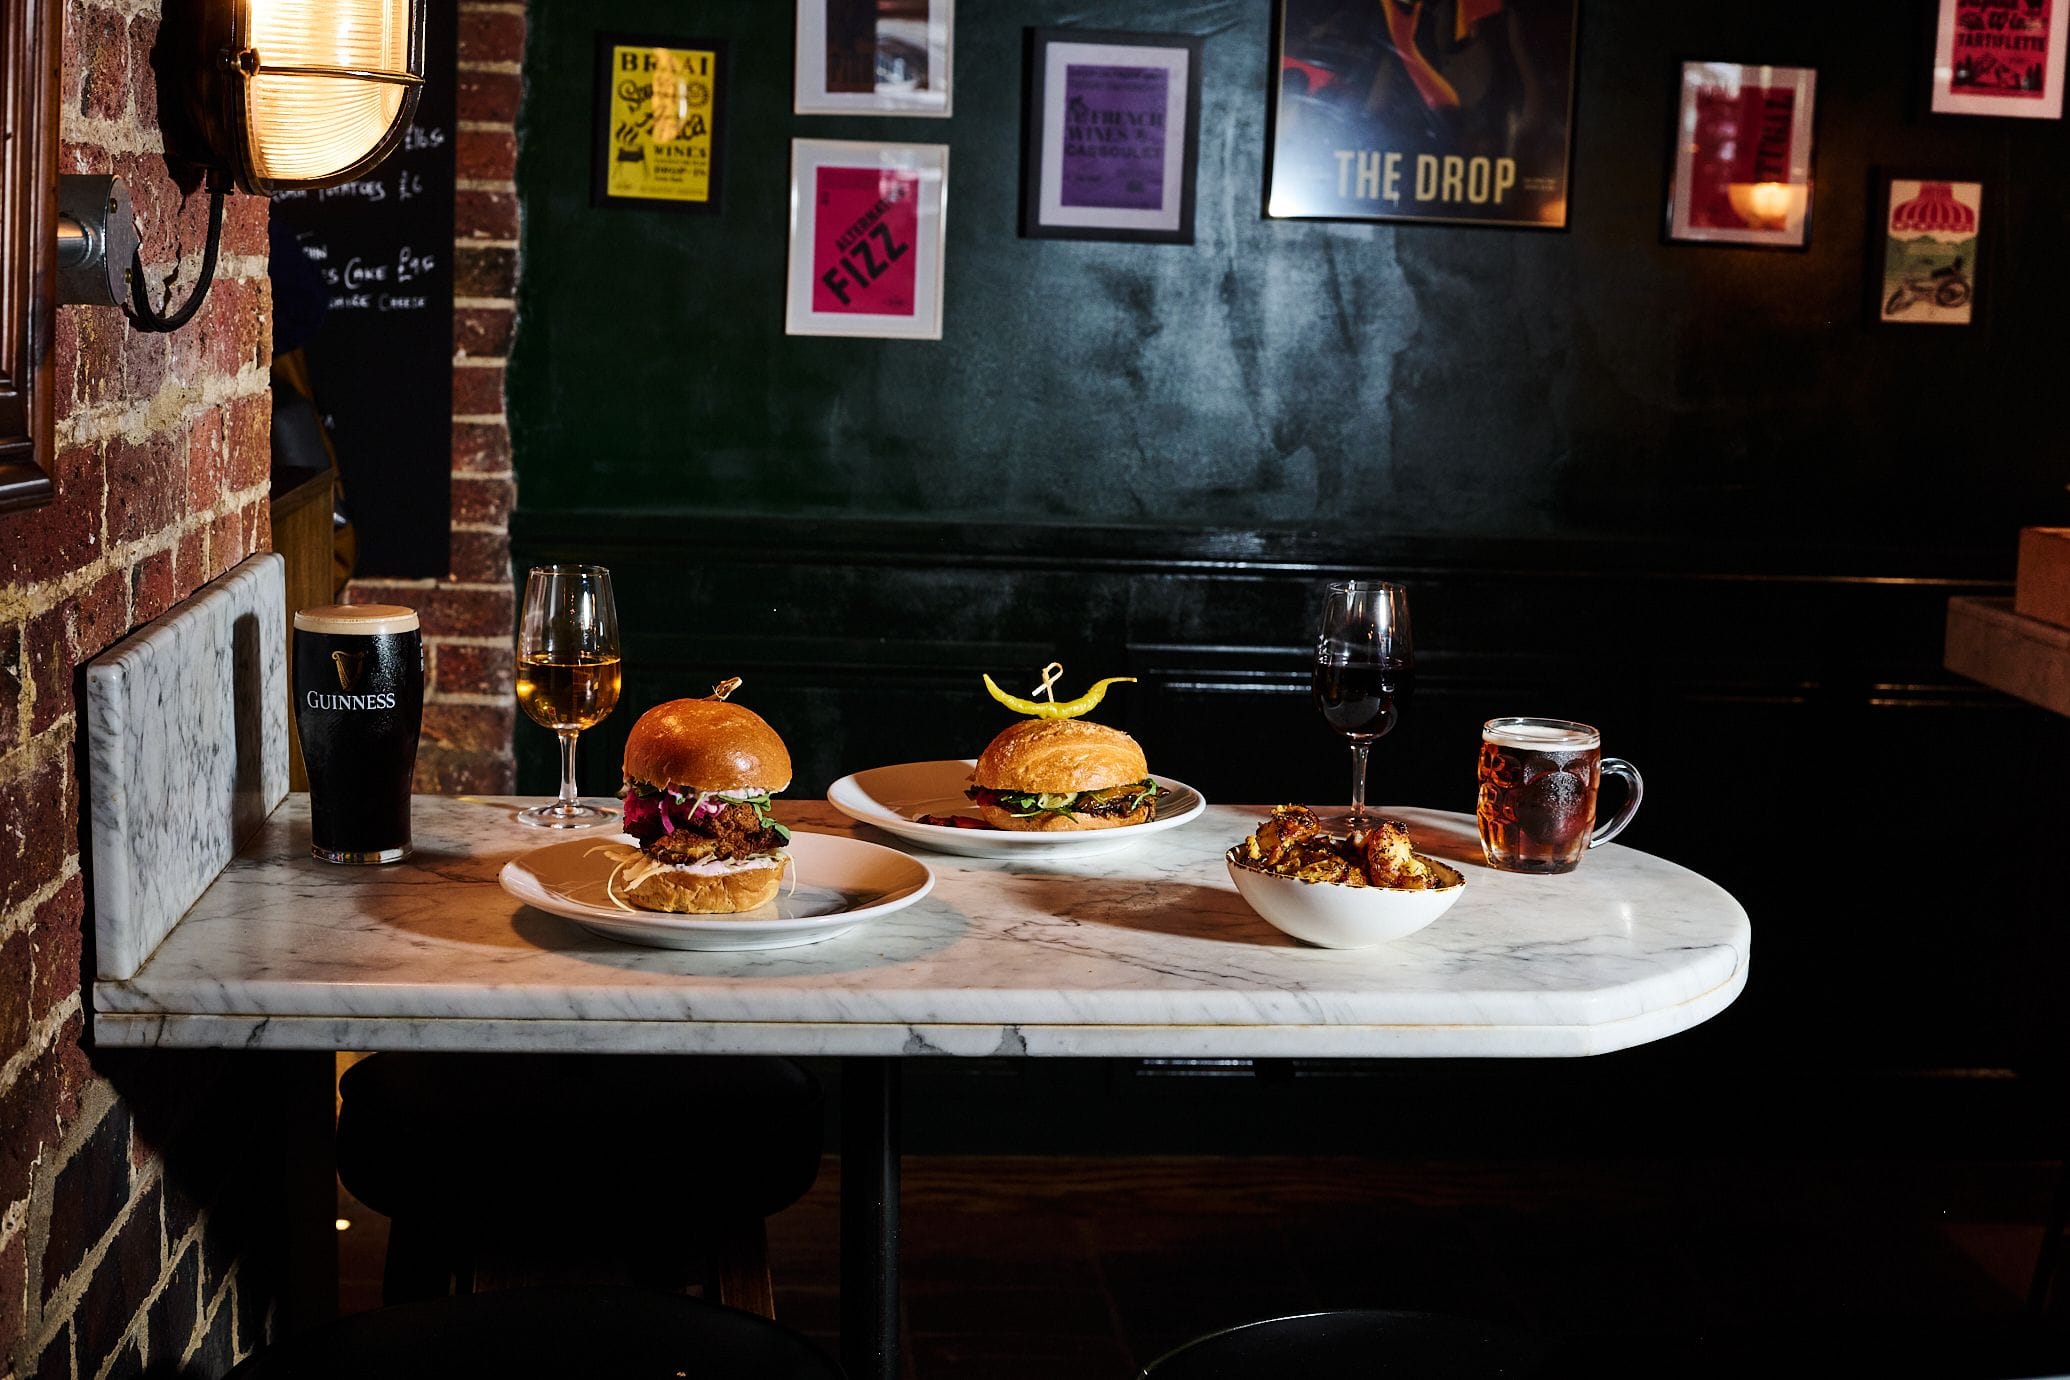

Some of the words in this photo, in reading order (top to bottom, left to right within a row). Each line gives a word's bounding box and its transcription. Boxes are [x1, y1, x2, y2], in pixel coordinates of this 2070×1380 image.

[1335, 150, 1402, 200] THE
[1415, 154, 1517, 204] DROP
[822, 222, 909, 305] FIZZ
[306, 690, 396, 711] GUINNESS
